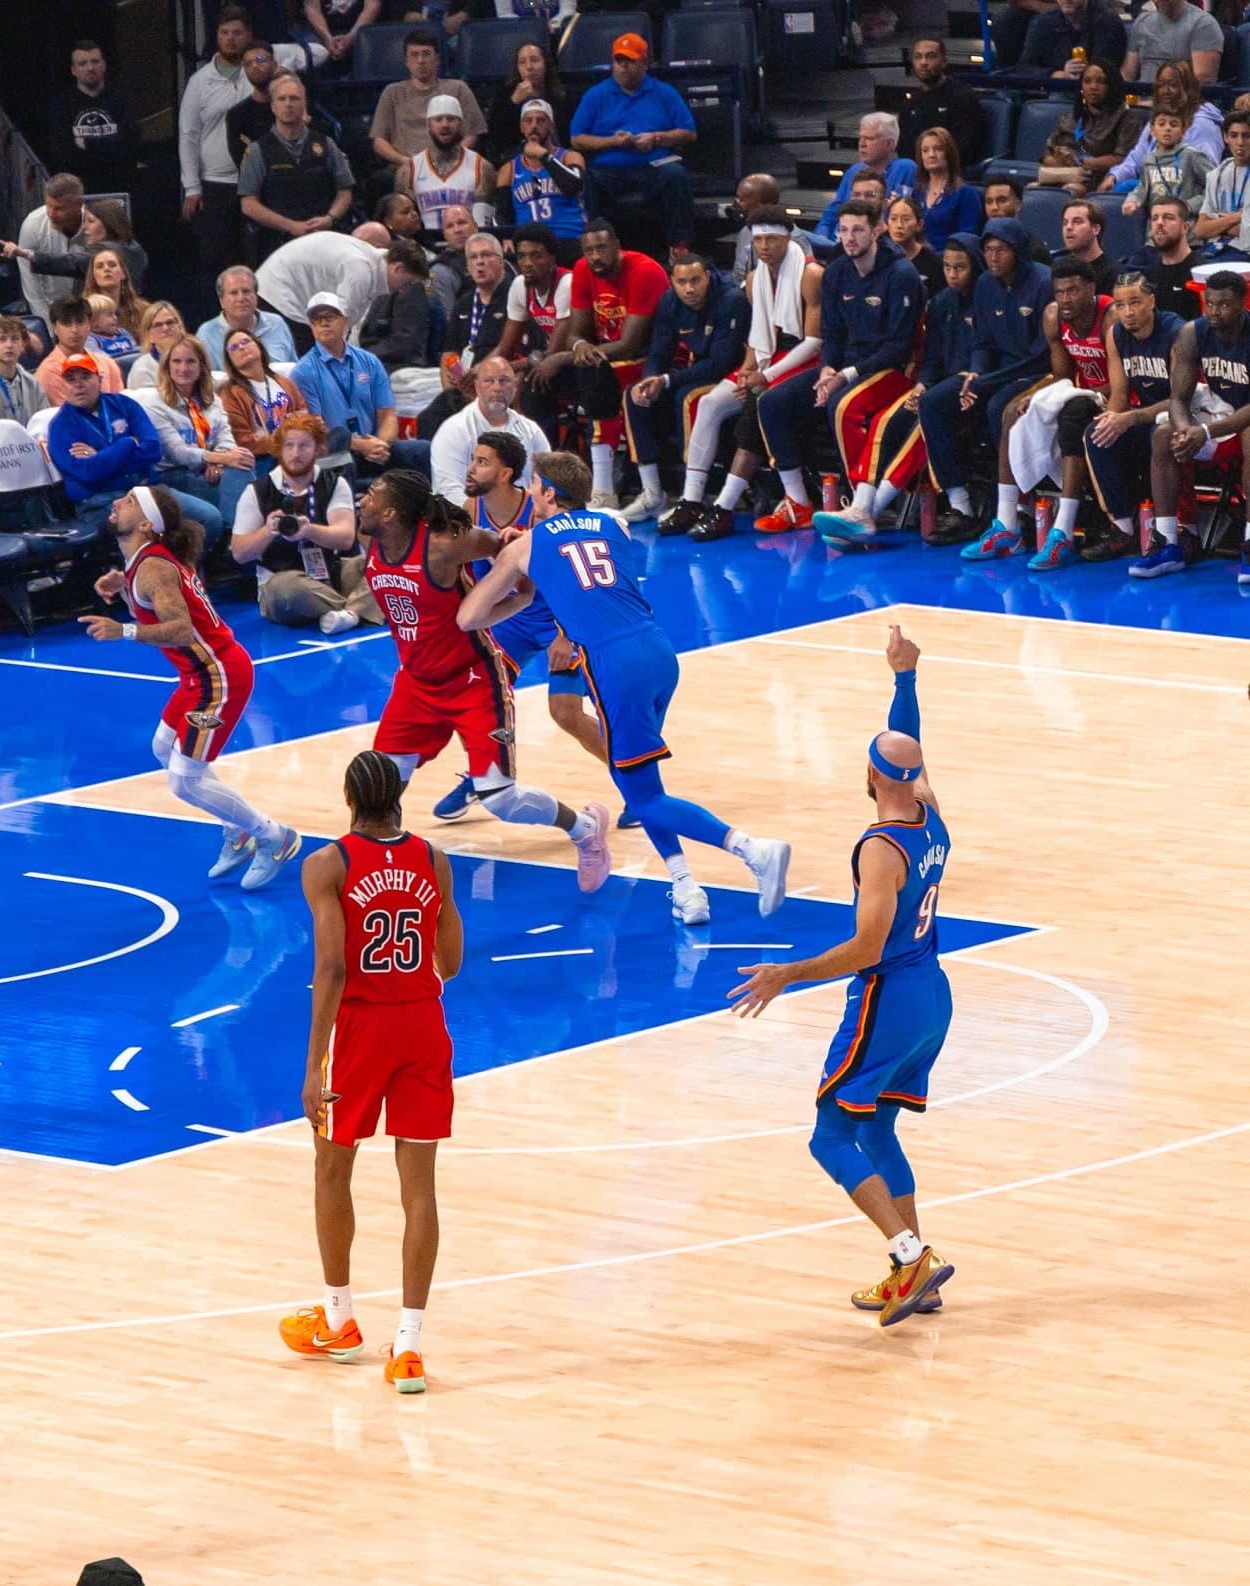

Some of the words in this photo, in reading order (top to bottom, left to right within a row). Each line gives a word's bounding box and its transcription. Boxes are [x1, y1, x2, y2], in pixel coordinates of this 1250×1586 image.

[527, 198, 552, 223] 13
[545, 517, 602, 535] CARLSON
[558, 539, 618, 591] 15
[371, 573, 420, 597] CRESCENT
[384, 593, 419, 626] 55
[397, 623, 418, 642] CITY
[347, 868, 418, 909] MURPHY
[414, 878, 437, 908] III
[914, 884, 939, 942] 9
[360, 908, 422, 974] 25
